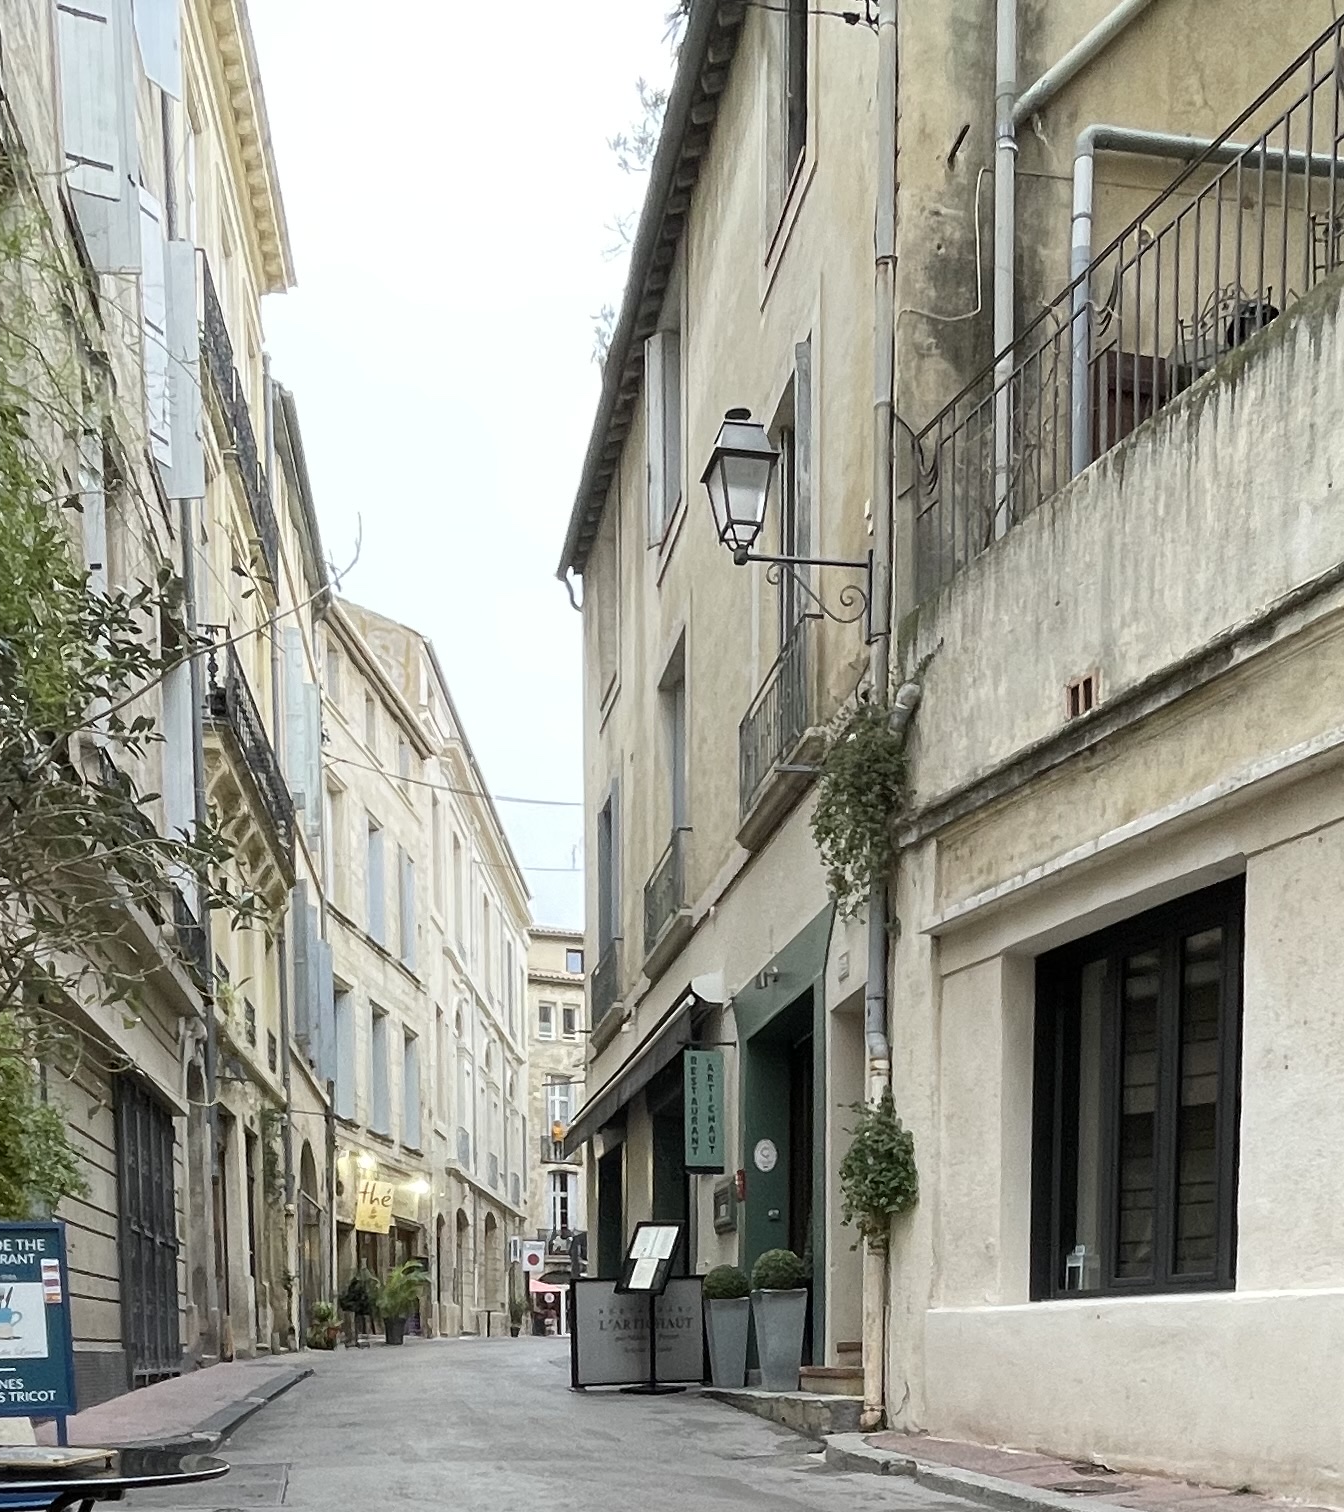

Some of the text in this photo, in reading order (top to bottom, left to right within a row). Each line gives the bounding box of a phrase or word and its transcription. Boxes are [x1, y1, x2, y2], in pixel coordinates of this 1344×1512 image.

[690, 1056, 699, 1156] RESTAURANT
[359, 1181, 392, 1208] thé
[15, 1239, 46, 1252] THE
[8, 1389, 56, 1402] TRICOT
